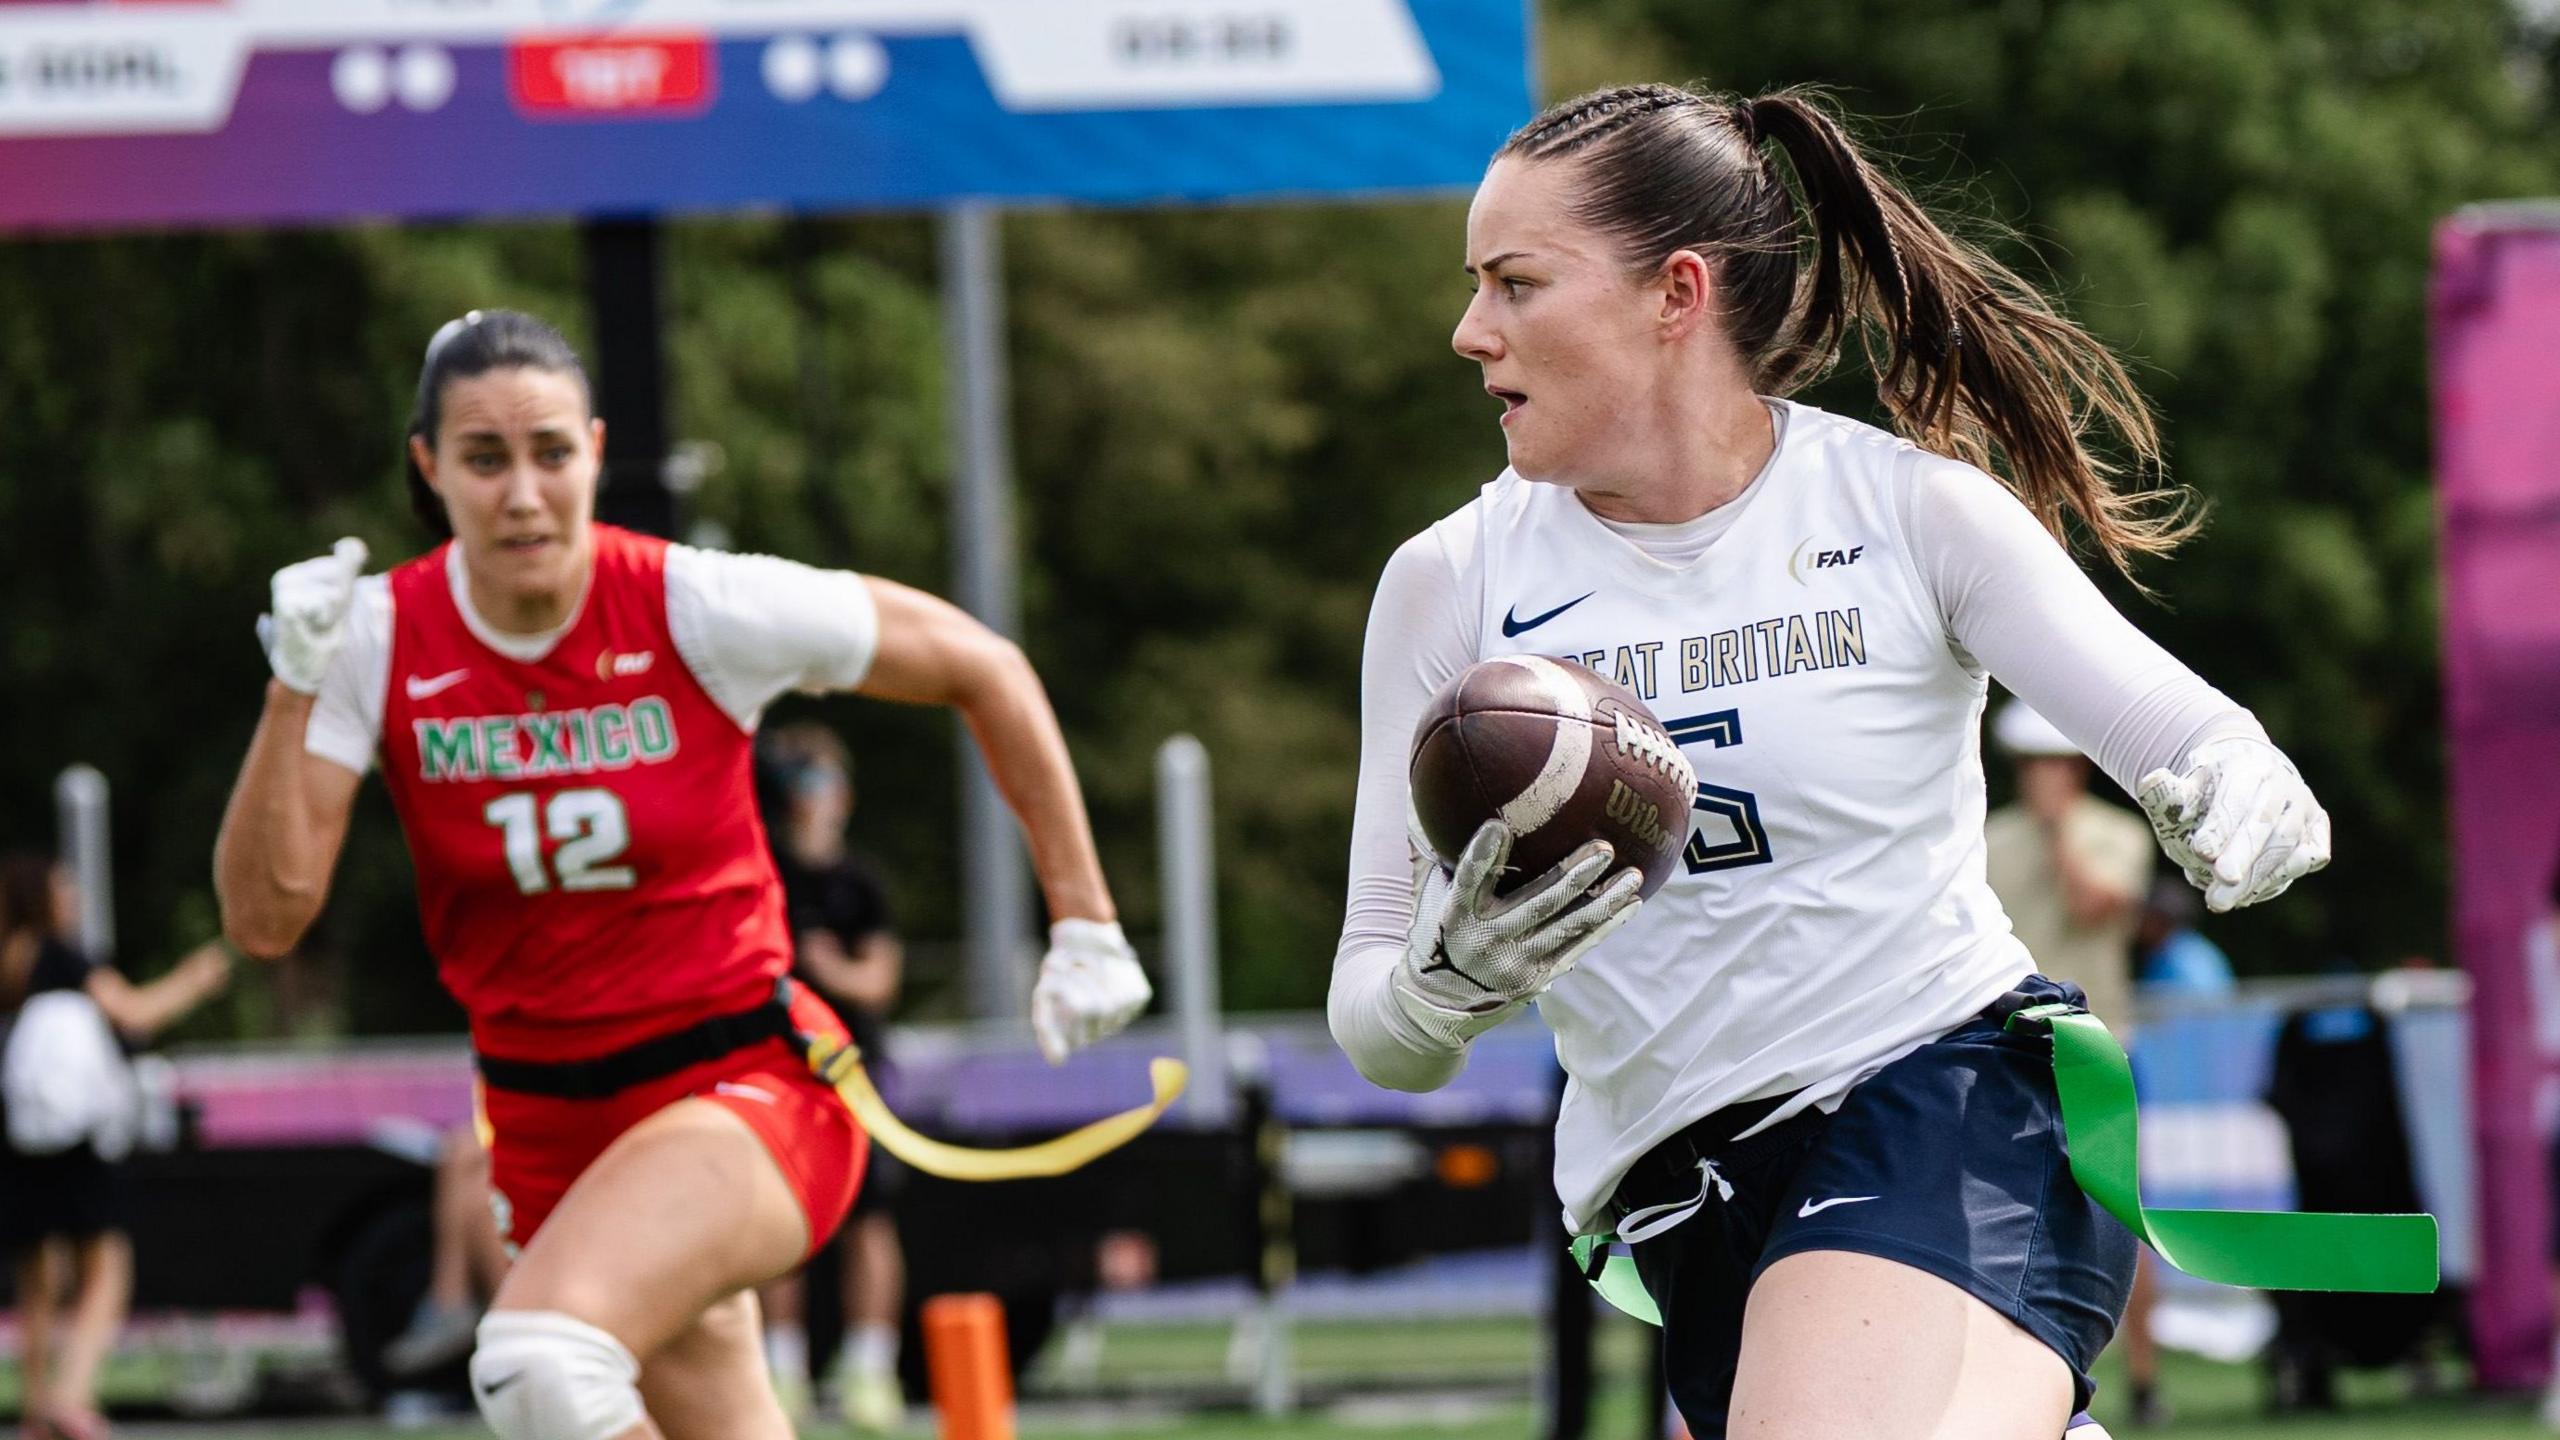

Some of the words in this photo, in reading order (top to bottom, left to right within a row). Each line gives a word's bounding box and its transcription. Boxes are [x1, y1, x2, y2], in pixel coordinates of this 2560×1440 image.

[1806, 545, 1864, 570] IFAF
[1681, 607, 1867, 694] BRITAIN
[412, 694, 680, 784] MEXICO
[1606, 778, 1679, 859] Wilson
[1661, 708, 1773, 875] 5
[484, 785, 637, 896] 12
